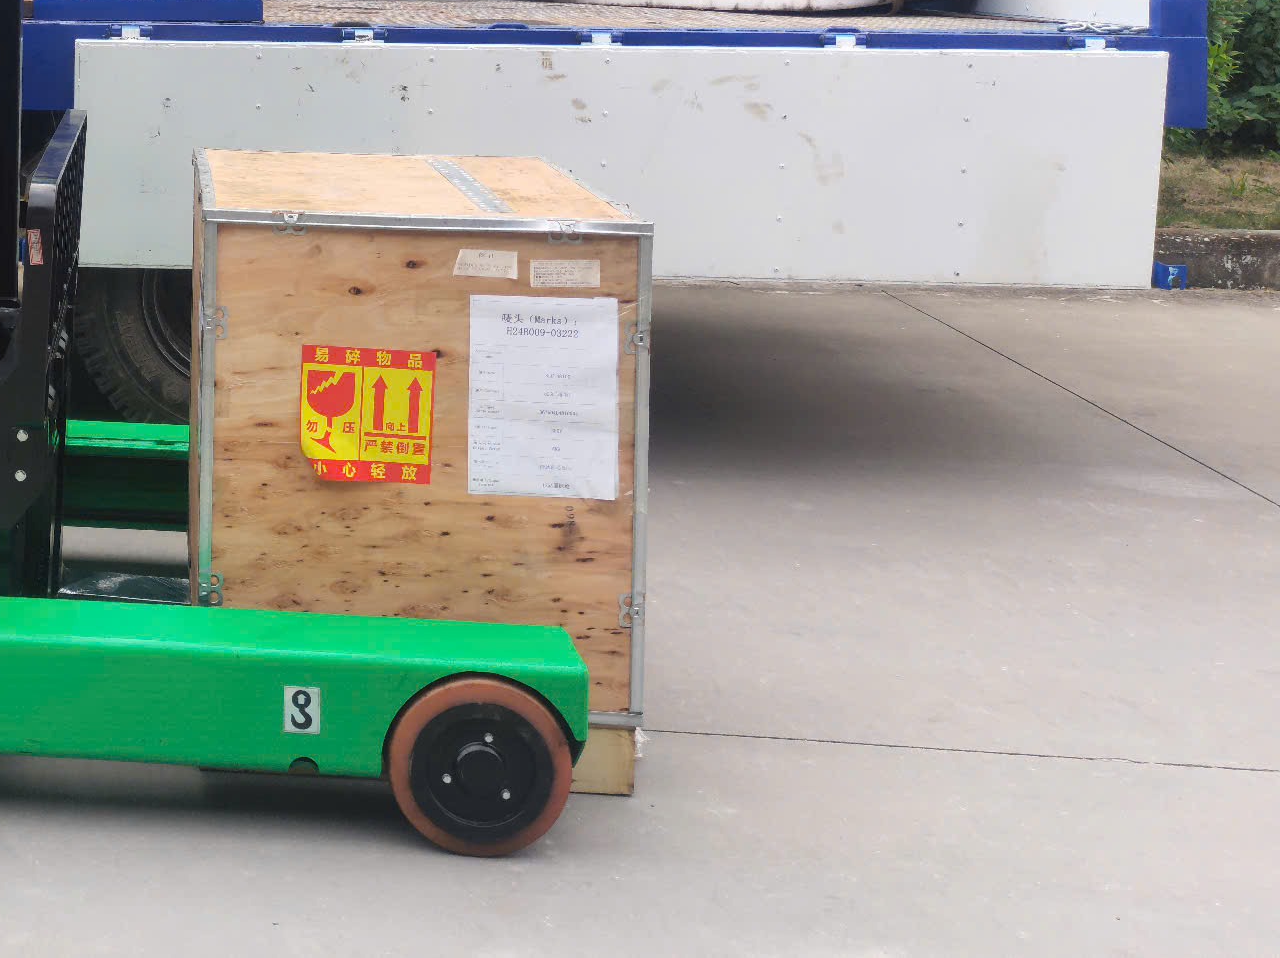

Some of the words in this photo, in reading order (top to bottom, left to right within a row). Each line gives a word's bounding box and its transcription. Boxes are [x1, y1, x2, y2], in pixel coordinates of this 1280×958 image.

[314, 346, 423, 369] 易碎物品
[306, 419, 356, 434] 勿压
[385, 421, 407, 433] 向上
[363, 439, 426, 456] 严禁倒置
[313, 460, 418, 481] 小心轻放
